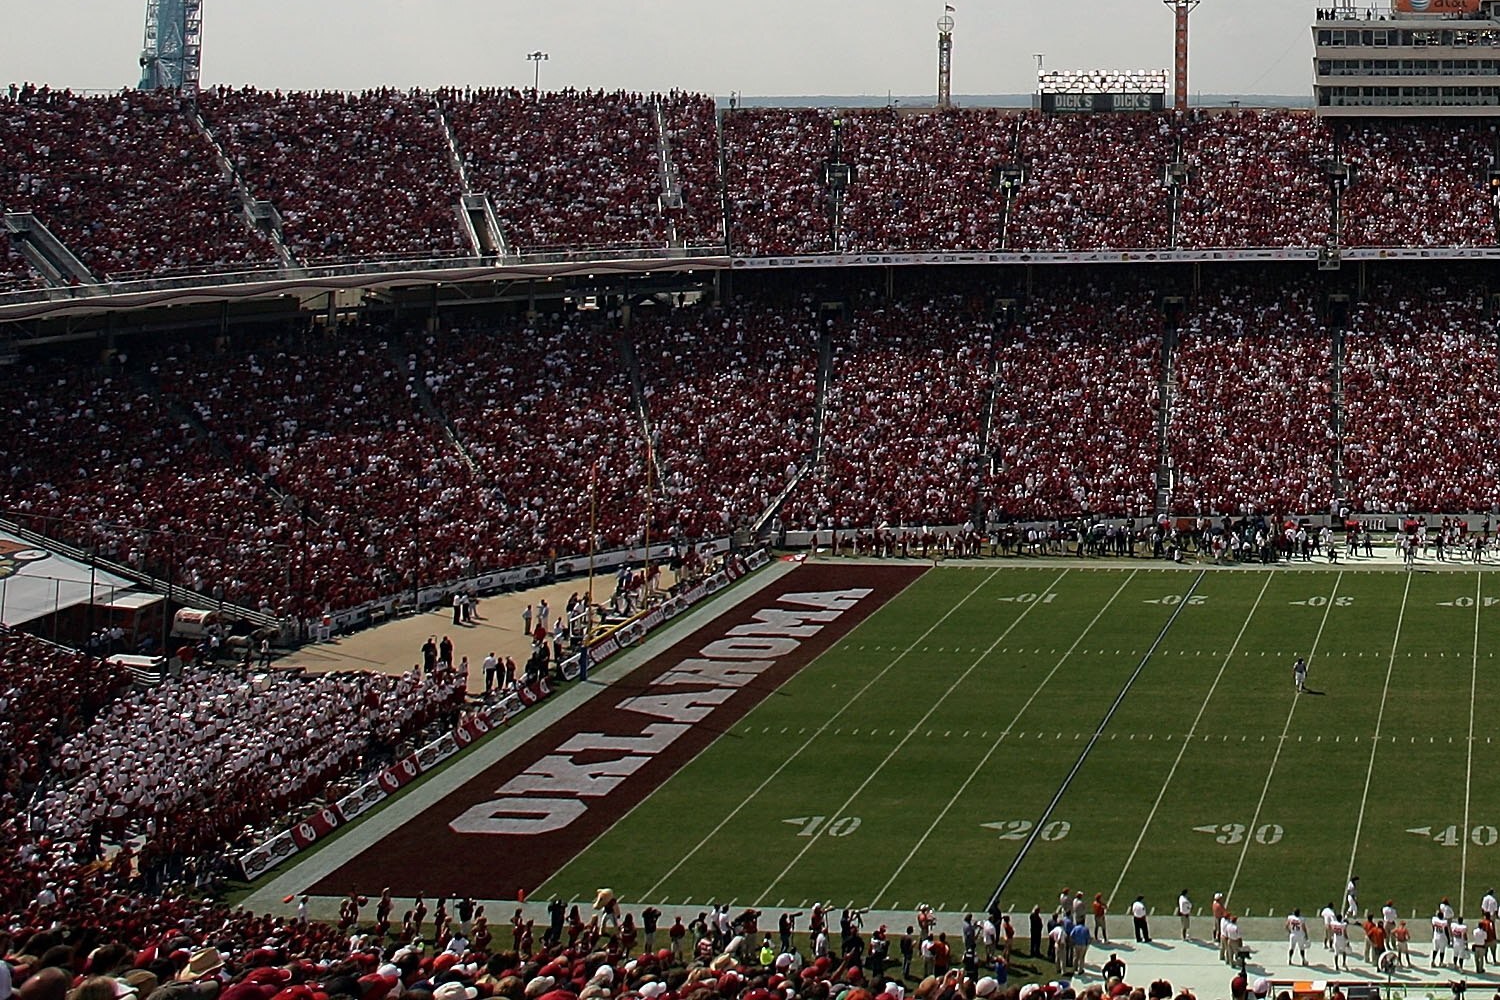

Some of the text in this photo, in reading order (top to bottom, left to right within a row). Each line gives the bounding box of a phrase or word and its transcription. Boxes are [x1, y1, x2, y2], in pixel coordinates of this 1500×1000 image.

[1055, 94, 1093, 107] DICK'S
[1113, 94, 1151, 107] DICK'S
[448, 587, 875, 835] OKLAHOMA
[797, 815, 863, 838] 10
[999, 819, 1072, 842] 20
[1215, 823, 1285, 845] 30
[1432, 824, 1500, 847] 40
